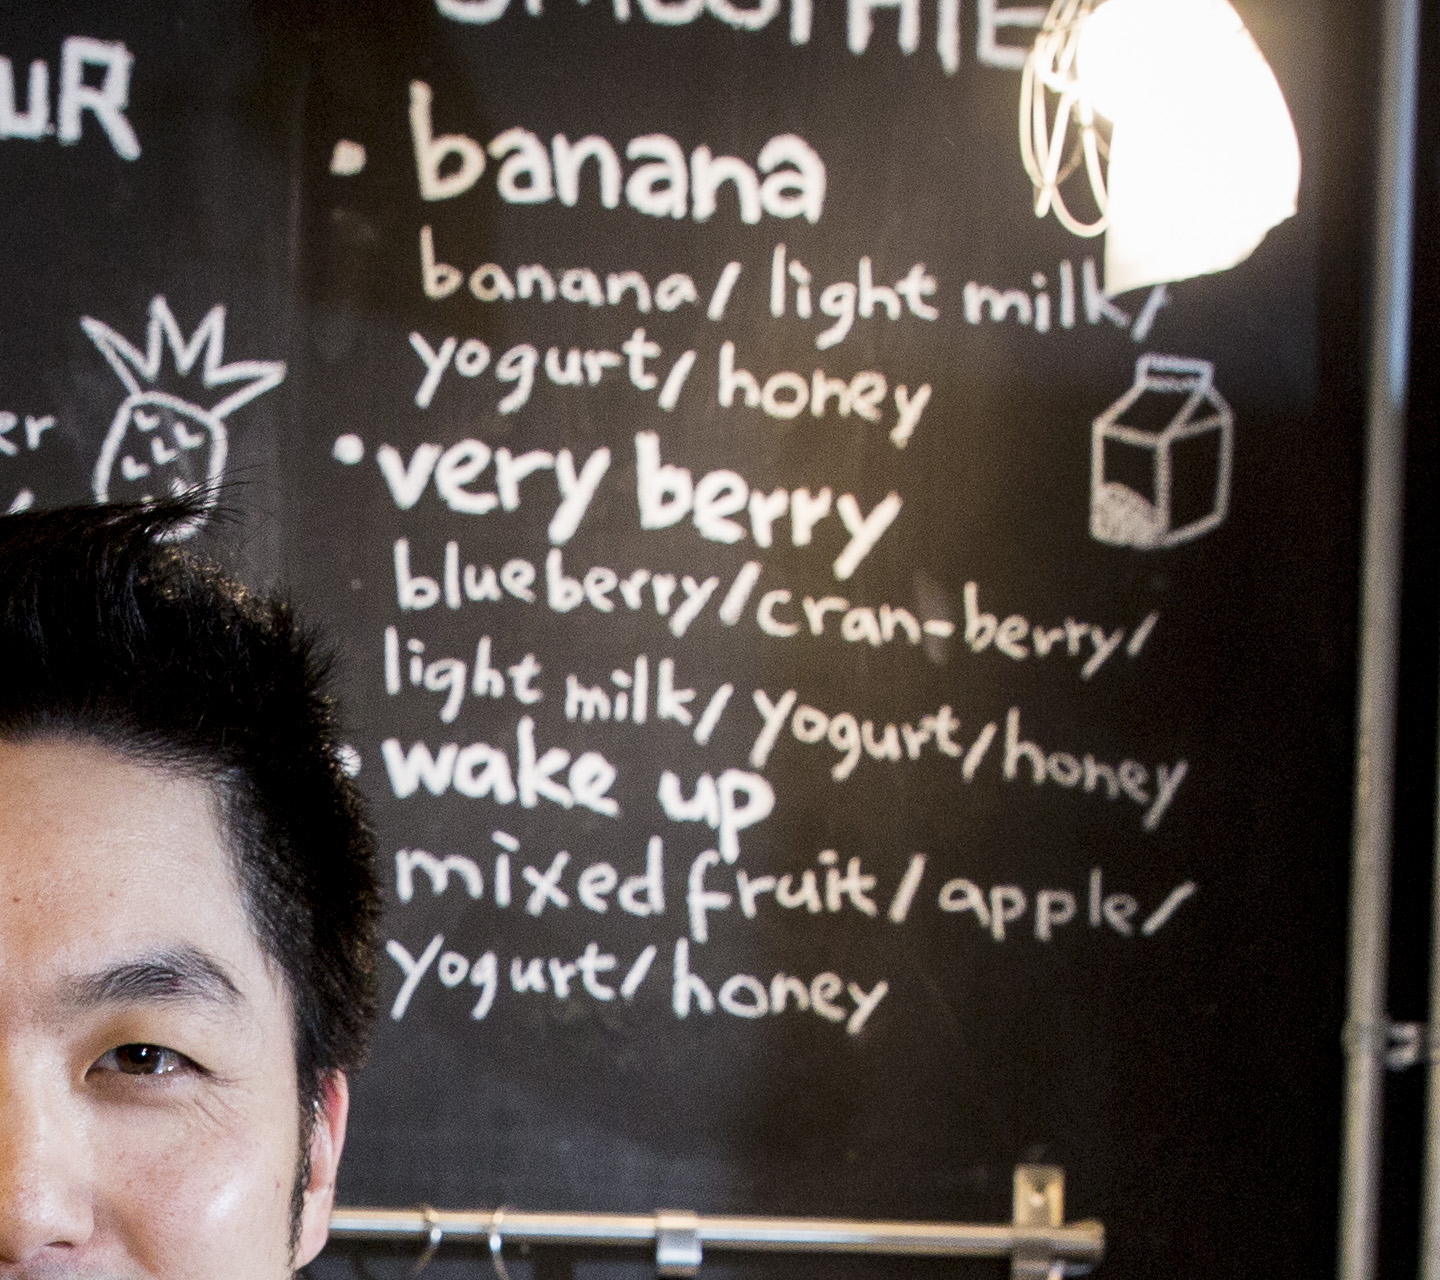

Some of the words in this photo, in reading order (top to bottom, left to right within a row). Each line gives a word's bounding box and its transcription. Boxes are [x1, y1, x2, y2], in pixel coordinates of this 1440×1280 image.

[409, 81, 829, 226] banana
[768, 243, 939, 351] light
[376, 437, 612, 547] very
[633, 431, 902, 581] berry
[383, 625, 543, 724] light
[381, 715, 620, 818] wake
[656, 762, 776, 866] up
[394, 829, 666, 918] mixed
